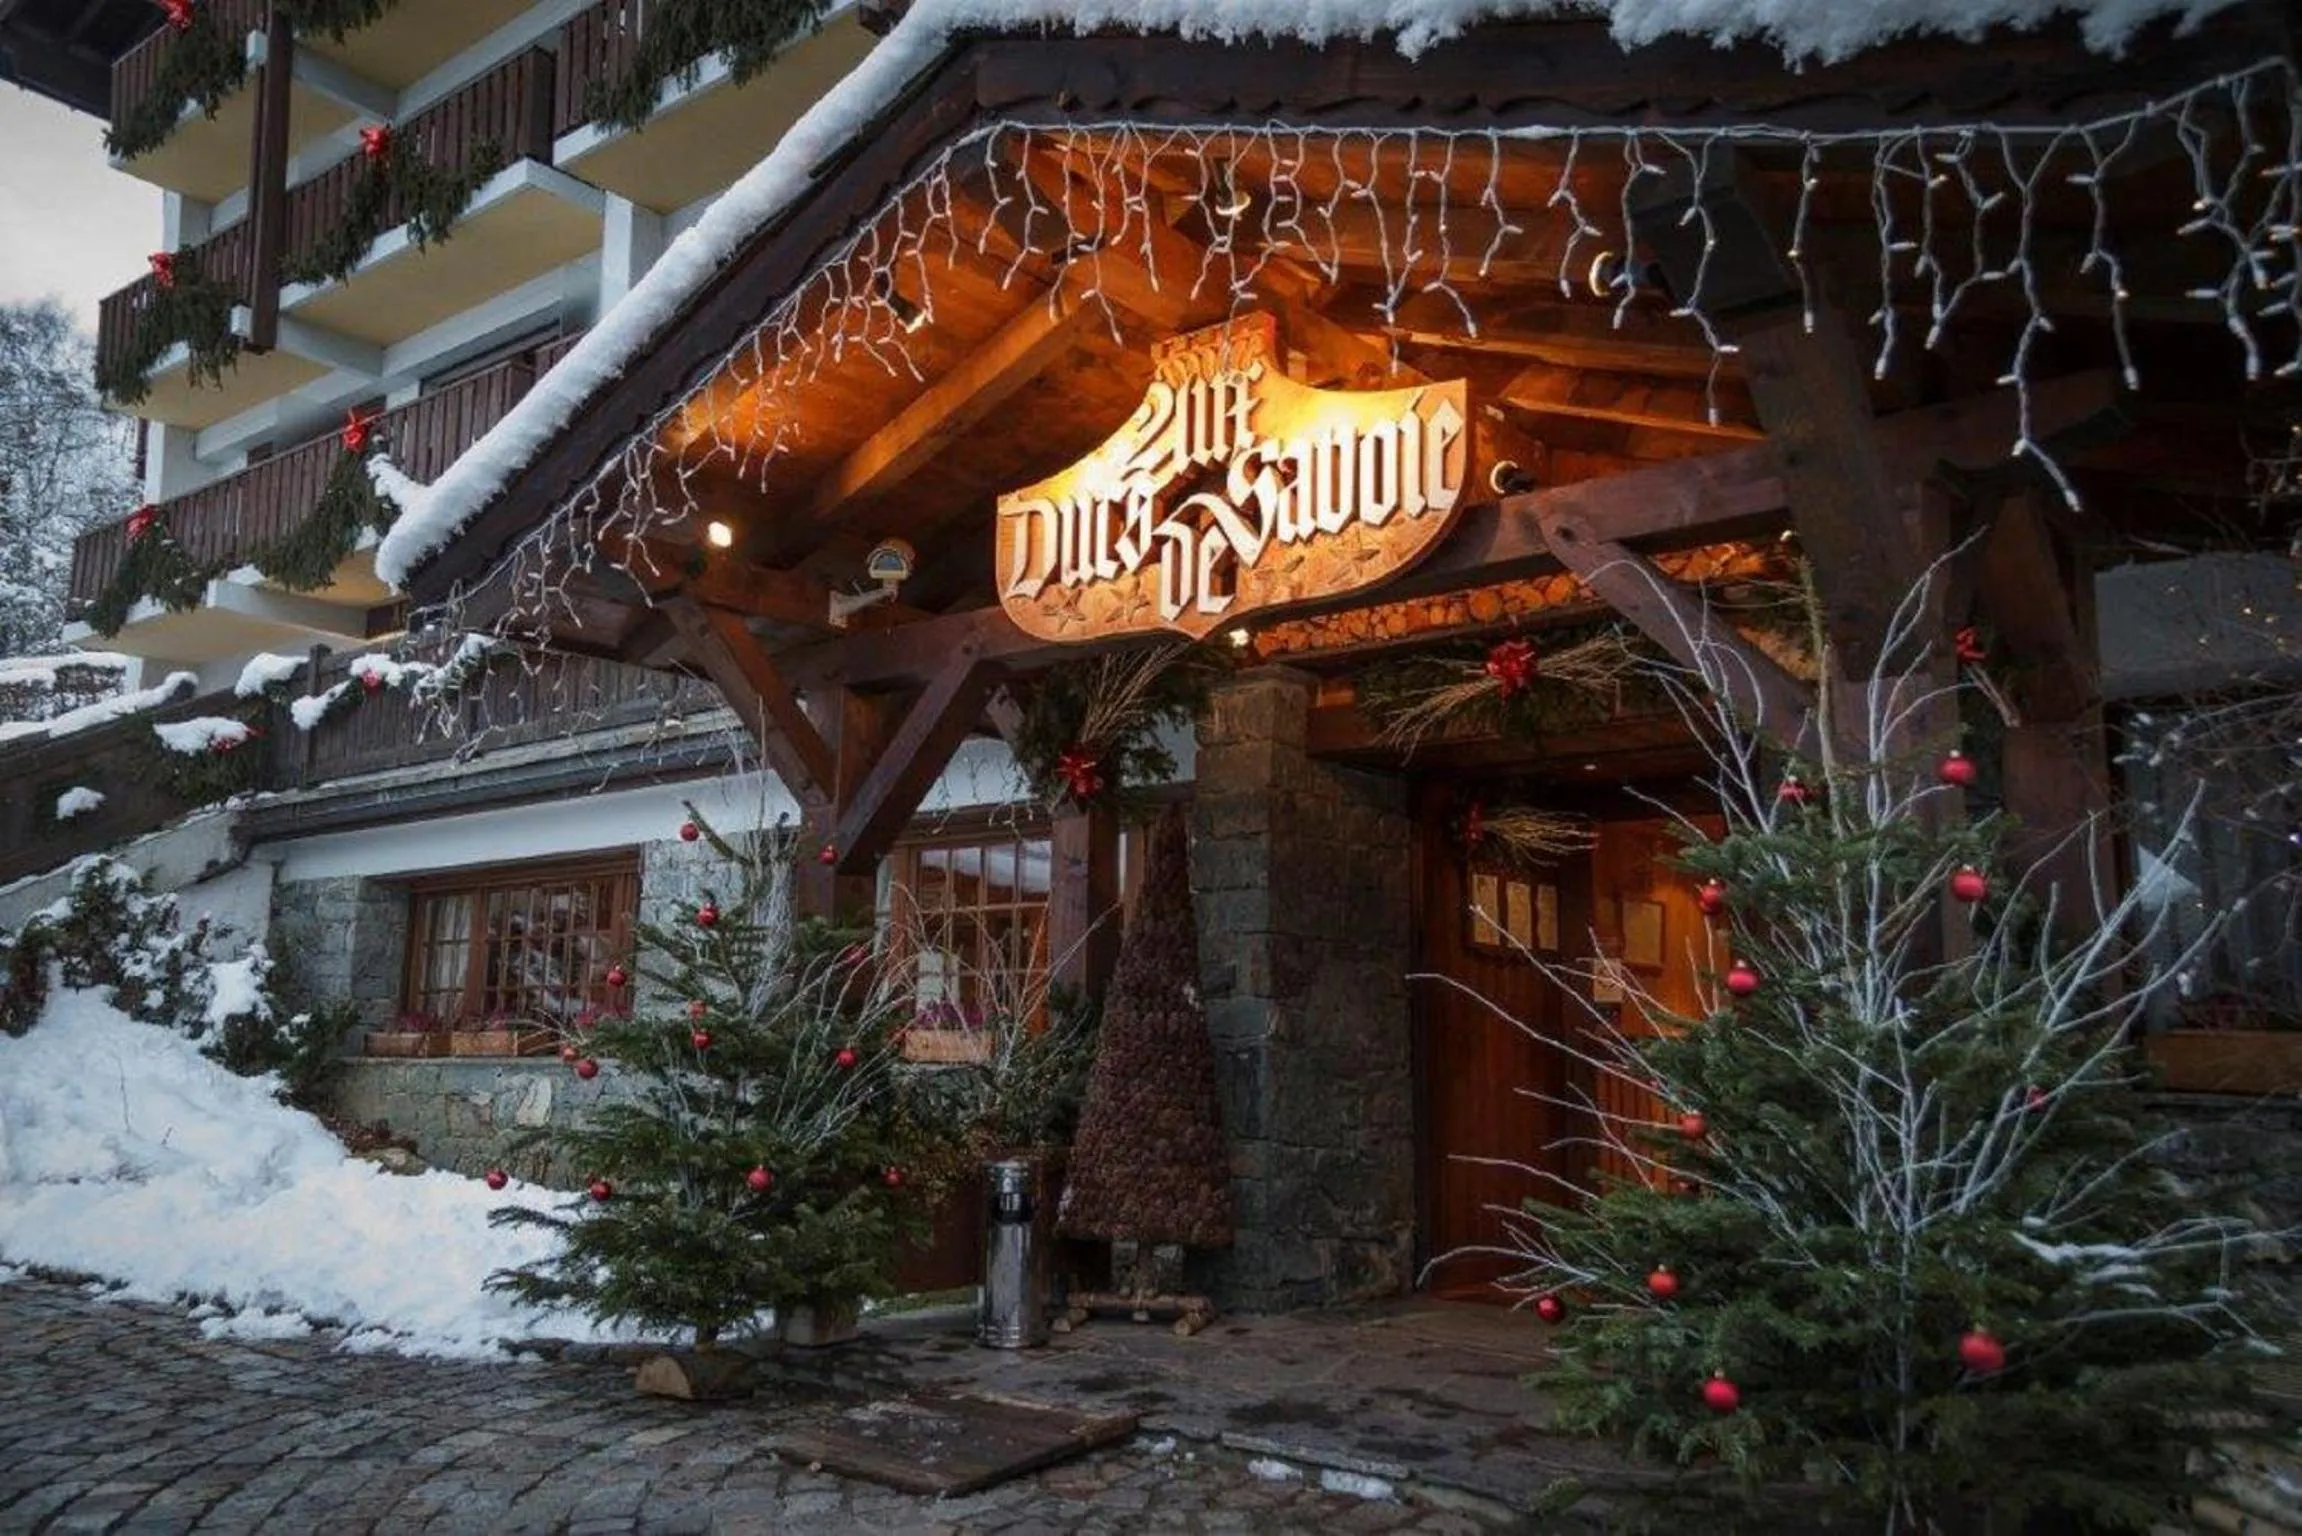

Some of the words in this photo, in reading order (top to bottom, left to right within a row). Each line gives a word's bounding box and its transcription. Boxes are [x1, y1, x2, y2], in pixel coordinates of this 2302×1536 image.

[1000, 467, 1154, 599] Ducs
[1172, 396, 1464, 568] Savoie
[1122, 361, 1263, 488] Aux
